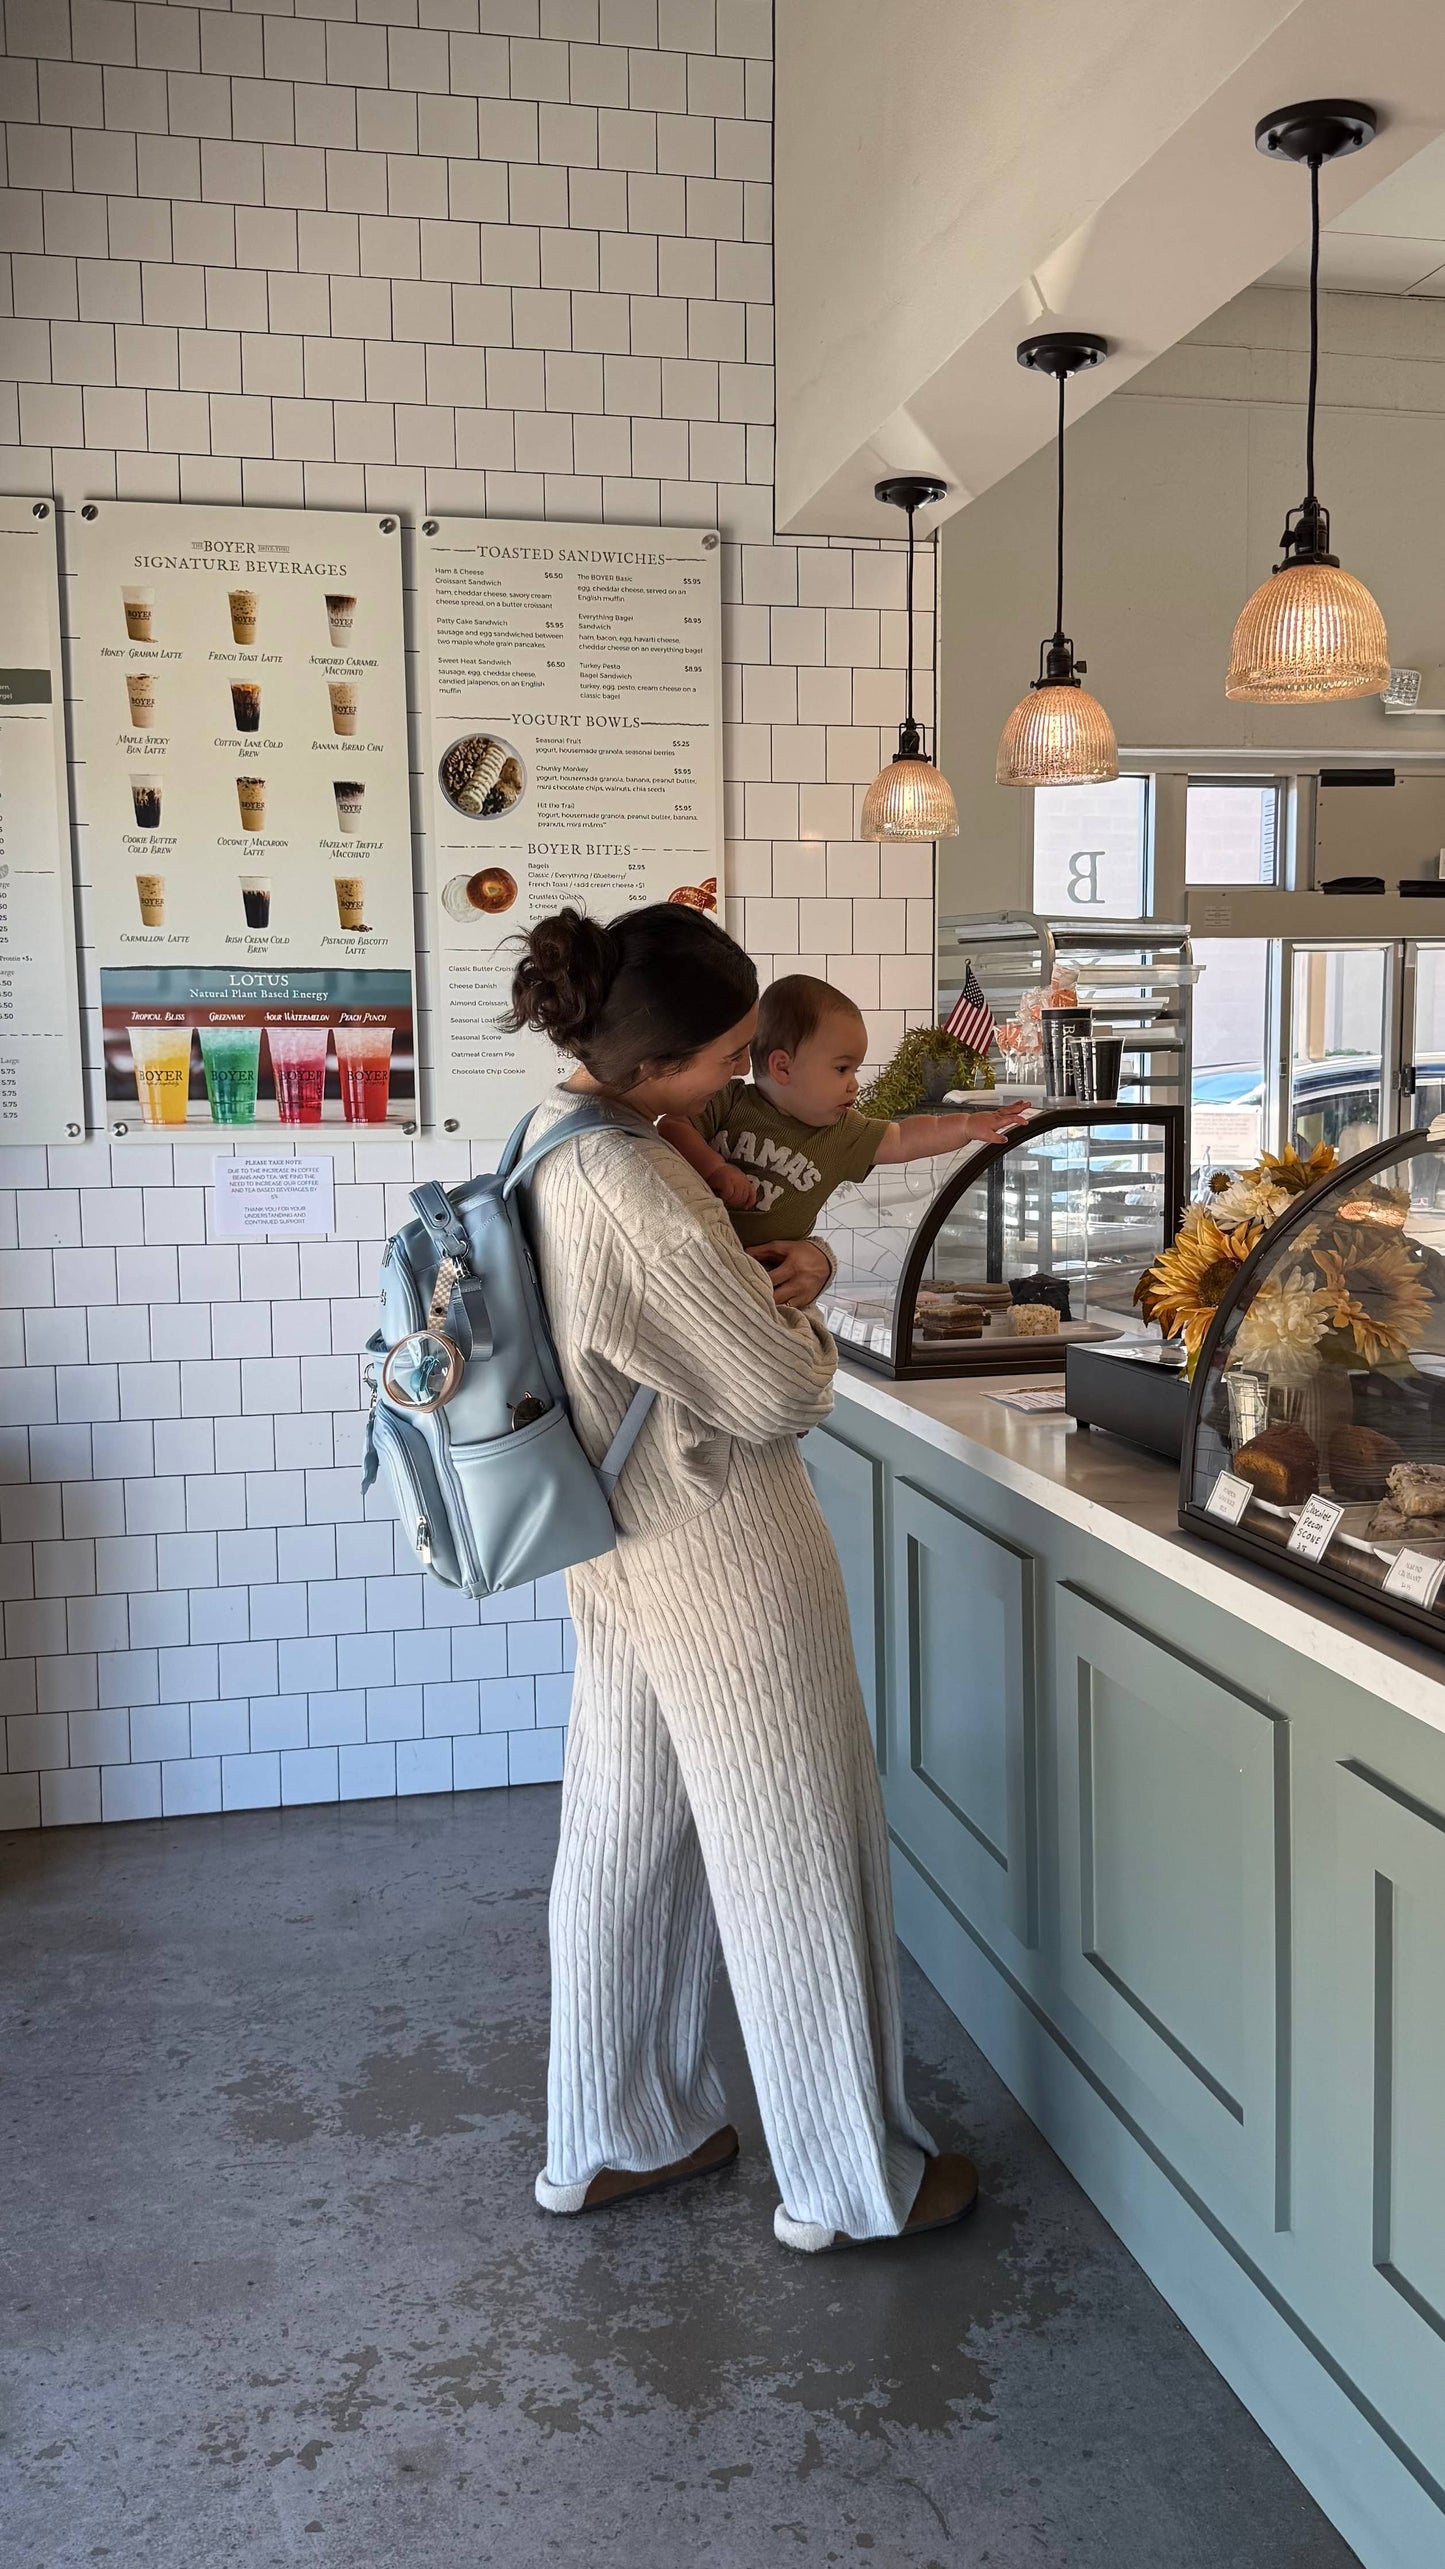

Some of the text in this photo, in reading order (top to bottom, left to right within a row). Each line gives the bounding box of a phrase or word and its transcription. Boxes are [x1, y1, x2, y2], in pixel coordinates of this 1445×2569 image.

[203, 540, 256, 553] BOYER
[477, 546, 665, 565] TOASTED SANDWICHES
[134, 555, 347, 576] SIGNATURE BEVERAGES
[436, 617, 454, 625] Patty
[100, 647, 183, 659] HONEY GRAHAM LATTE
[209, 651, 283, 663] FRENCH TOAST LATTE
[346, 657, 379, 667] CARAMEL
[580, 662, 601, 670] Turkey
[512, 713, 640, 728] YOGURT BOWLS
[116, 735, 143, 745] MAPLE
[214, 738, 283, 748] COTTON LANE COLD
[126, 745, 166, 755] BUN LATTE
[312, 741, 384, 752] BANANA BREAD CHAI
[238, 748, 259, 758] BREW
[122, 835, 177, 844] COOKIE BUTTER
[217, 837, 289, 847] COCONUT MACAROON
[319, 839, 384, 849] HAZELNUT TRUFFLE
[128, 845, 172, 854] COLD BREW
[243, 848, 265, 856] LATTE
[528, 843, 631, 856] BOYER BITES
[168, 934, 190, 943] LATTE
[225, 935, 290, 944] IRISH CREAM COLD
[320, 936, 356, 946] PISTACHIO
[247, 945, 268, 953] BREW
[345, 946, 366, 955] LATTE
[230, 974, 289, 986] LOTUS
[190, 989, 329, 1001] Natural Plant Based Energy
[131, 1011, 186, 1021] TROPICAL BLISS
[209, 1012, 246, 1021] GREENWAY
[264, 1010, 330, 1022] SOUR WATERMELON
[339, 1012, 387, 1023] PEACH PUNCH
[139, 1070, 183, 1081] BOYER
[211, 1070, 254, 1081] BOYER
[347, 1070, 388, 1081] BOYER
[1297, 1528, 1321, 1544] SCONE
